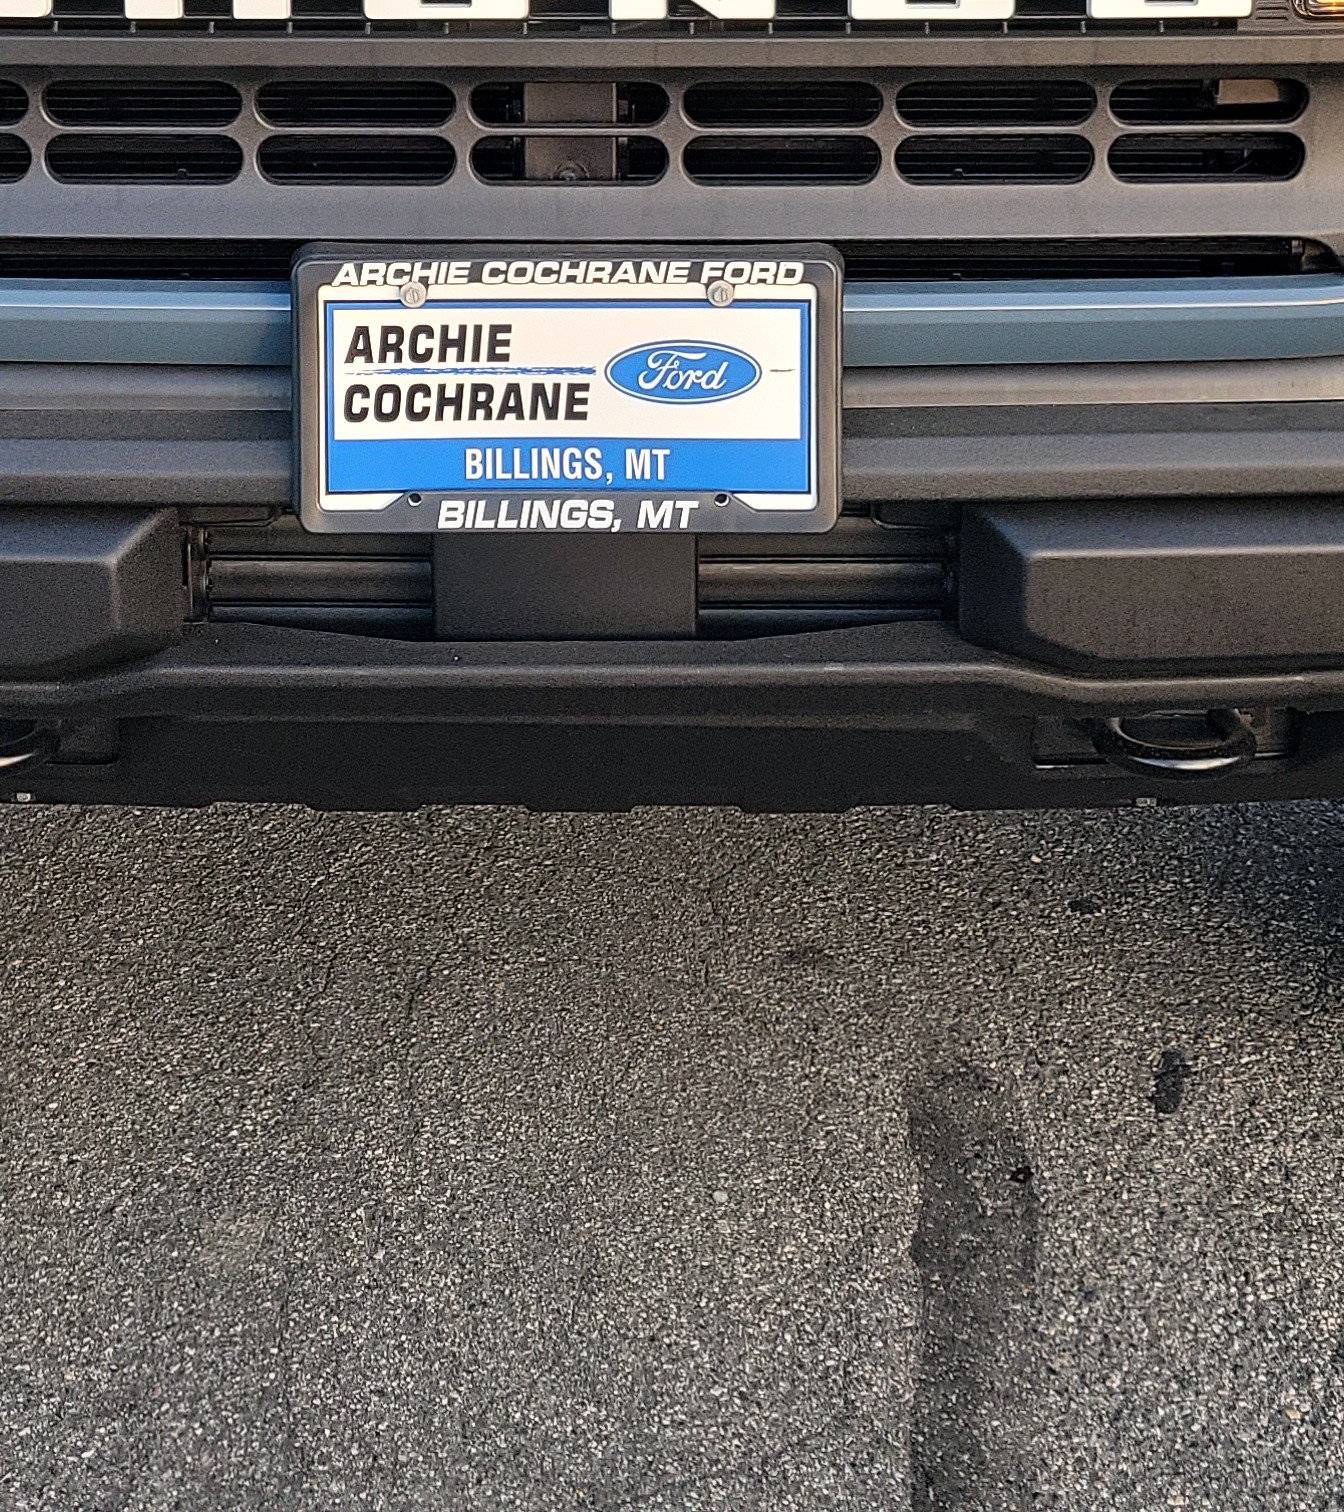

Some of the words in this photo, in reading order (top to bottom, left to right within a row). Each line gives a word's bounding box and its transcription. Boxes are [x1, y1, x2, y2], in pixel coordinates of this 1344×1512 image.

[332, 261, 471, 287] ARCHIE
[481, 260, 695, 285] COCHRANE
[701, 260, 805, 285] FORD
[345, 324, 513, 364] ARCHIE
[638, 349, 730, 391] Ford
[343, 383, 590, 422] COCHRANE
[464, 448, 614, 485] BILLINGS,
[624, 449, 671, 481] MT
[436, 500, 623, 531] BILLINGS,
[630, 500, 699, 529] MT
